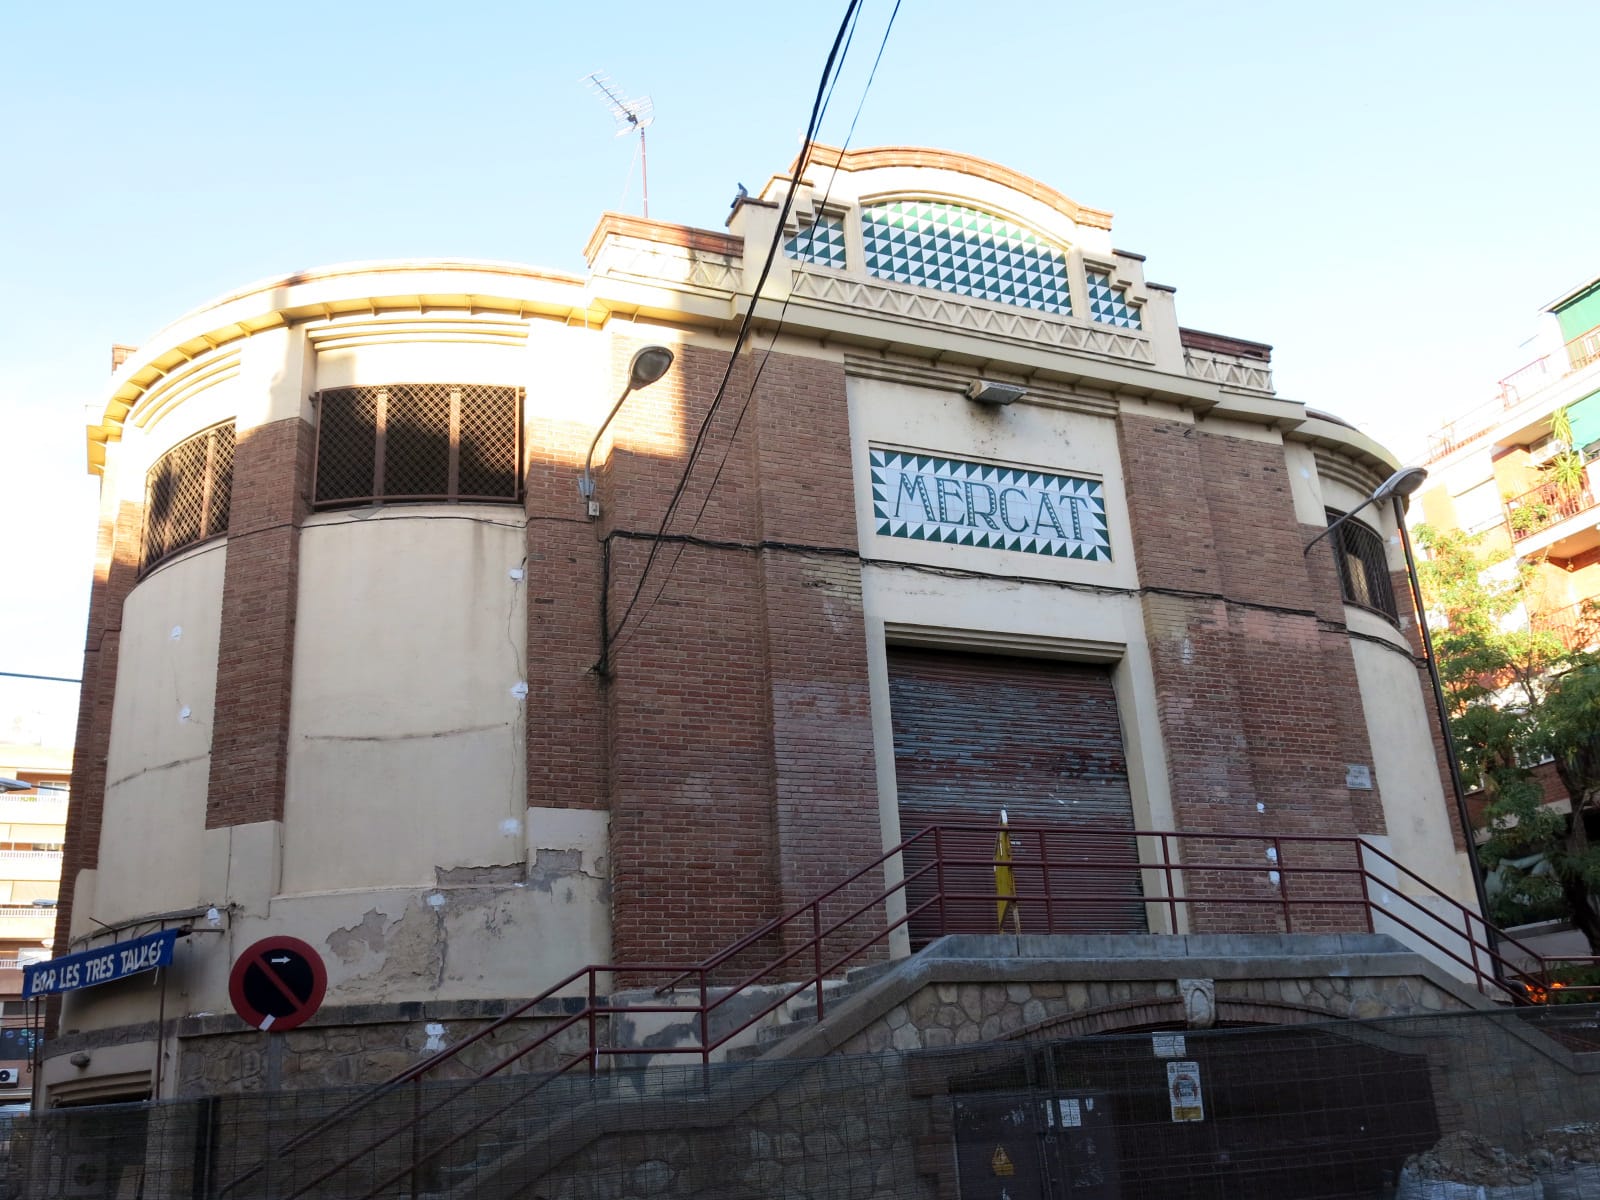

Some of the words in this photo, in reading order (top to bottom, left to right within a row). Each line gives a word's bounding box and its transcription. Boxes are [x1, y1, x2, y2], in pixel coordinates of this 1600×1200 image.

[893, 472, 1090, 542] MERCAT
[31, 969, 57, 993] BAR
[58, 963, 80, 989] LES
[85, 954, 114, 983] TRES
